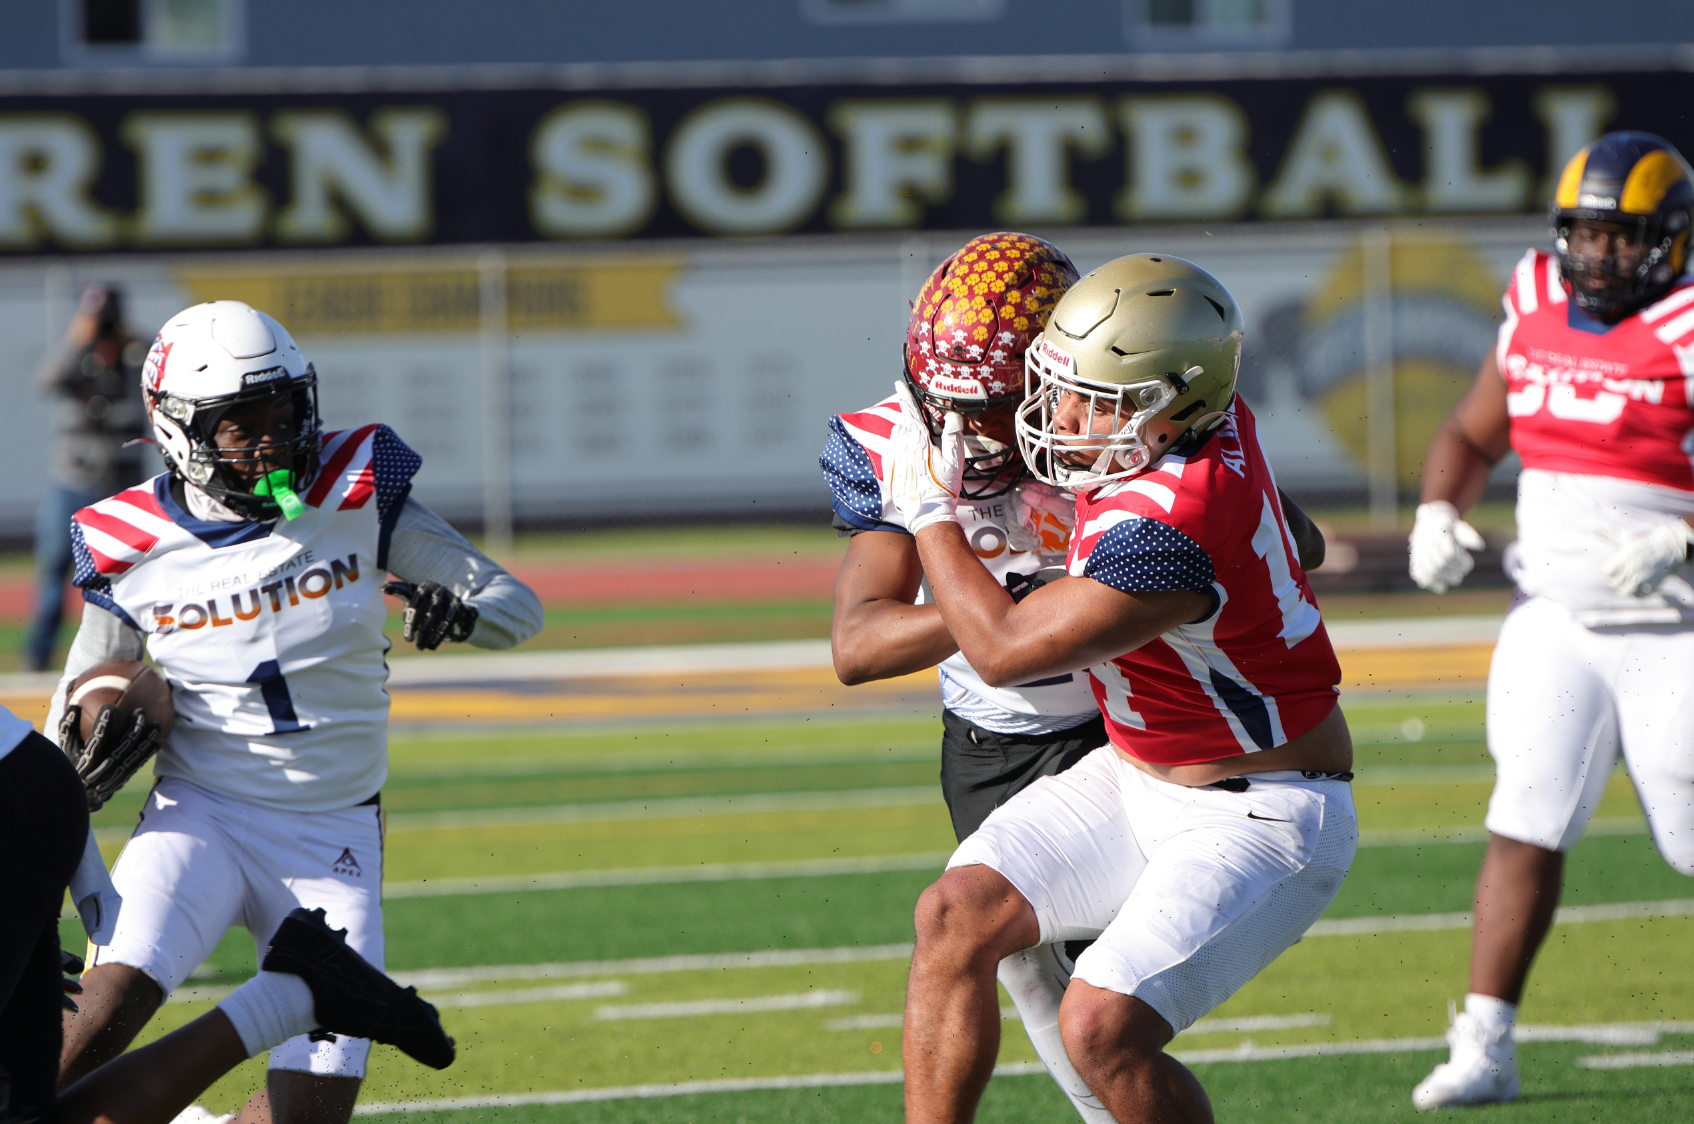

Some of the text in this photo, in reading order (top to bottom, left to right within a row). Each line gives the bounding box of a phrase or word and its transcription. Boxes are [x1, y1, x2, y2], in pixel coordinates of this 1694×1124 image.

[1043, 343, 1070, 367] Riddell
[244, 366, 286, 385] Riddell
[935, 381, 978, 395] Riddell
[968, 504, 1004, 521] THE
[177, 550, 316, 599] THE REAL ESTATE
[153, 553, 359, 634] SOLUTION
[245, 658, 311, 736] 1
